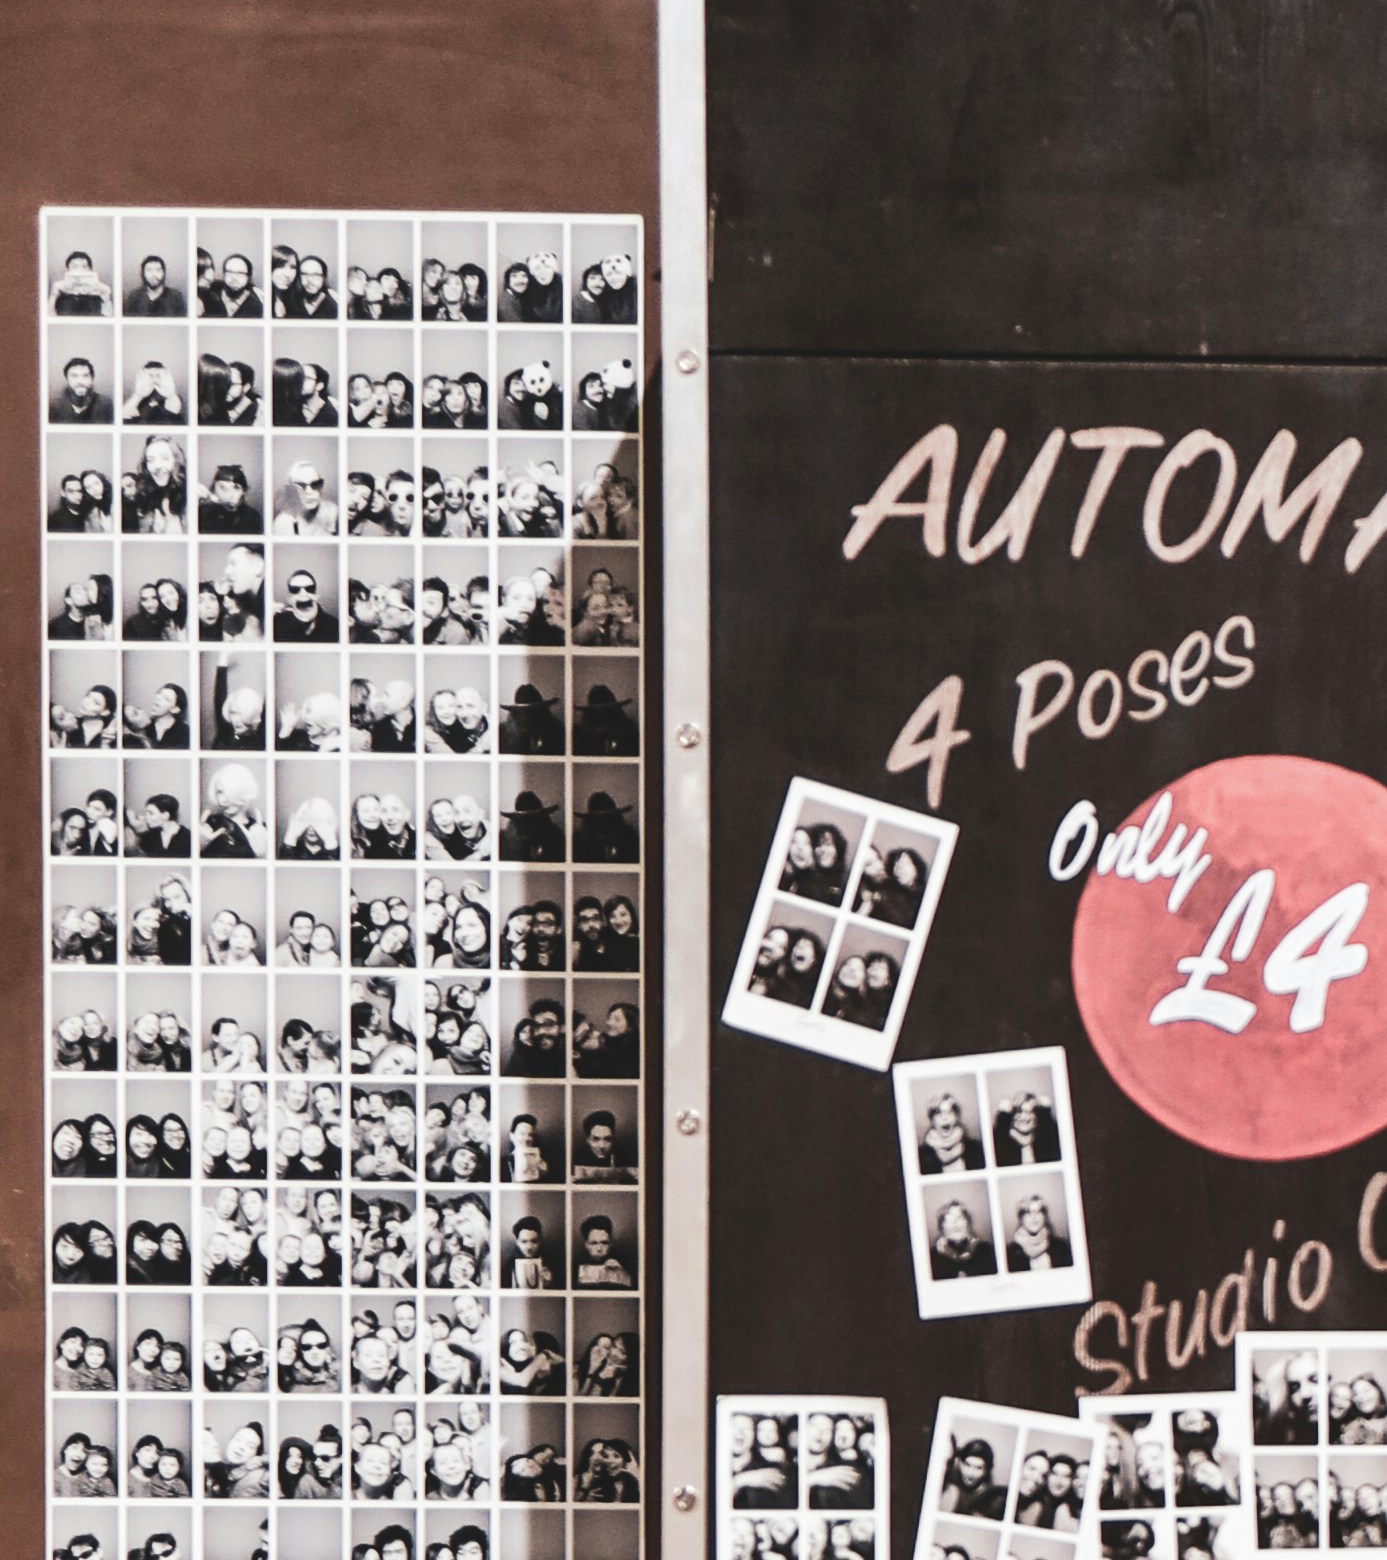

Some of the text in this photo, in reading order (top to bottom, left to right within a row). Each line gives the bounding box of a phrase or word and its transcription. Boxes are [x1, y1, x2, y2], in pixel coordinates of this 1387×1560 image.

[886, 614, 1257, 808] 4 Poses
[1046, 791, 1212, 914] Only
[1148, 868, 1371, 1035] £4
[1073, 1218, 1334, 1398] Studio
